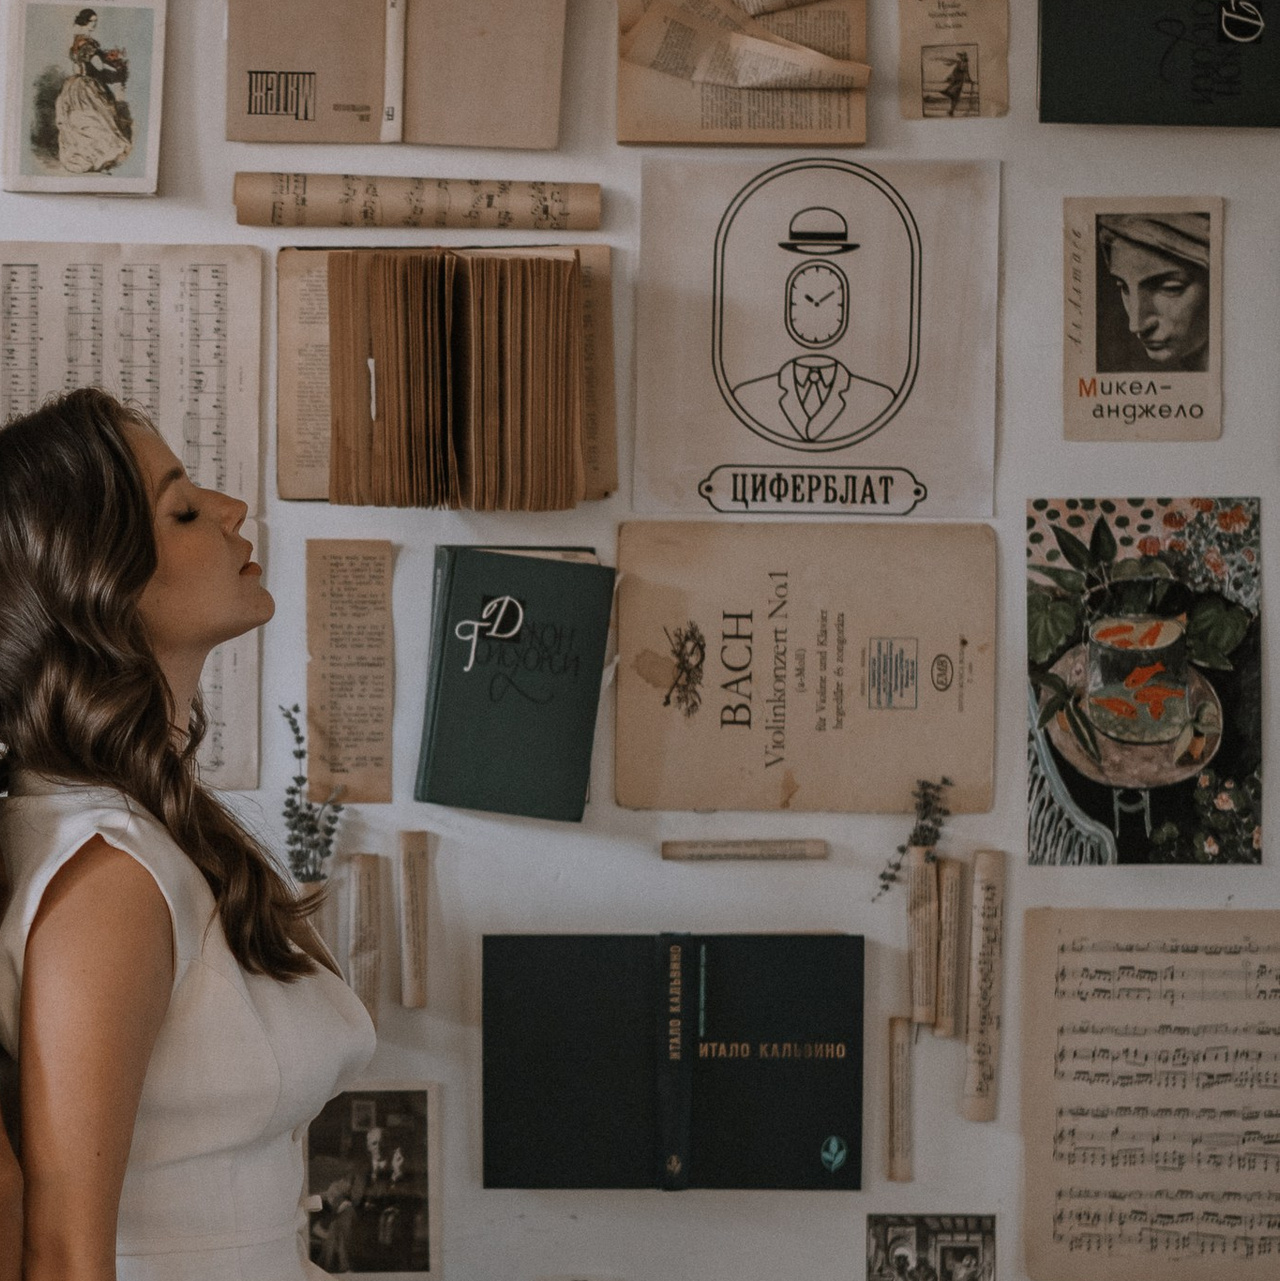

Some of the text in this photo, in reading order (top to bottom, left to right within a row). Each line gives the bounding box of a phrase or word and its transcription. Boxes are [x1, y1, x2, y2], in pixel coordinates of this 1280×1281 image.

[1078, 377, 1172, 398] Микел-
[1092, 401, 1204, 425] анджело
[730, 473, 895, 509] ЦИФЕРБЛАТ
[816, 609, 829, 647] Klavier
[720, 609, 754, 730] BACH
[816, 651, 828, 672] und
[764, 627, 787, 769] Violinkonzert
[816, 675, 828, 714] Violine
[668, 944, 682, 1061] ИТАЛО КАЛЬВИНО
[698, 1041, 750, 1059] ИТАЛО
